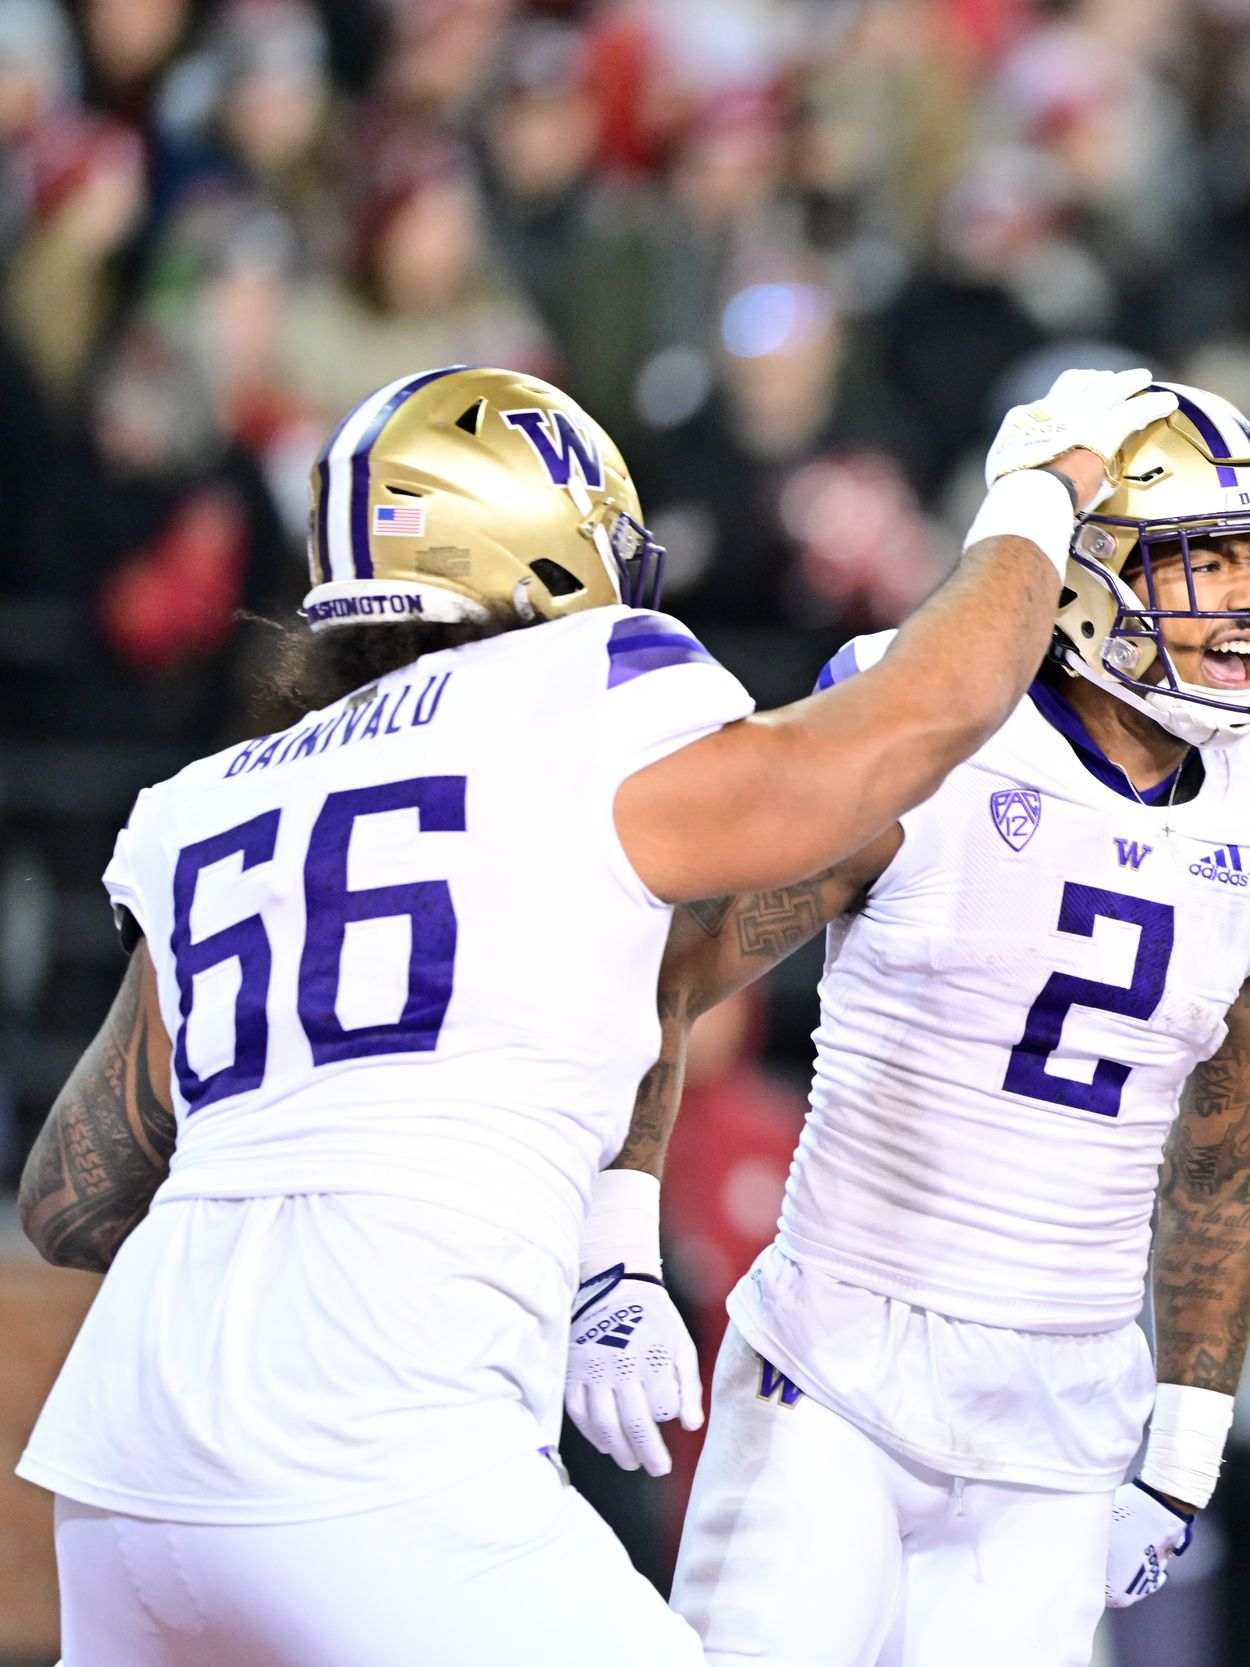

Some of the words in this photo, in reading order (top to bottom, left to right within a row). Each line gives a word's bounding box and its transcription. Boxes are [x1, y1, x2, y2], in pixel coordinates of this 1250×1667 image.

[500, 407, 605, 492] W
[993, 791, 1040, 826] PAC
[1006, 815, 1028, 837] 12
[1113, 836, 1153, 873] W
[1188, 863, 1249, 888] adidas
[171, 774, 469, 1119] 66
[1001, 881, 1175, 1118] 2
[576, 1303, 644, 1346] adidas
[756, 1352, 804, 1409] W
